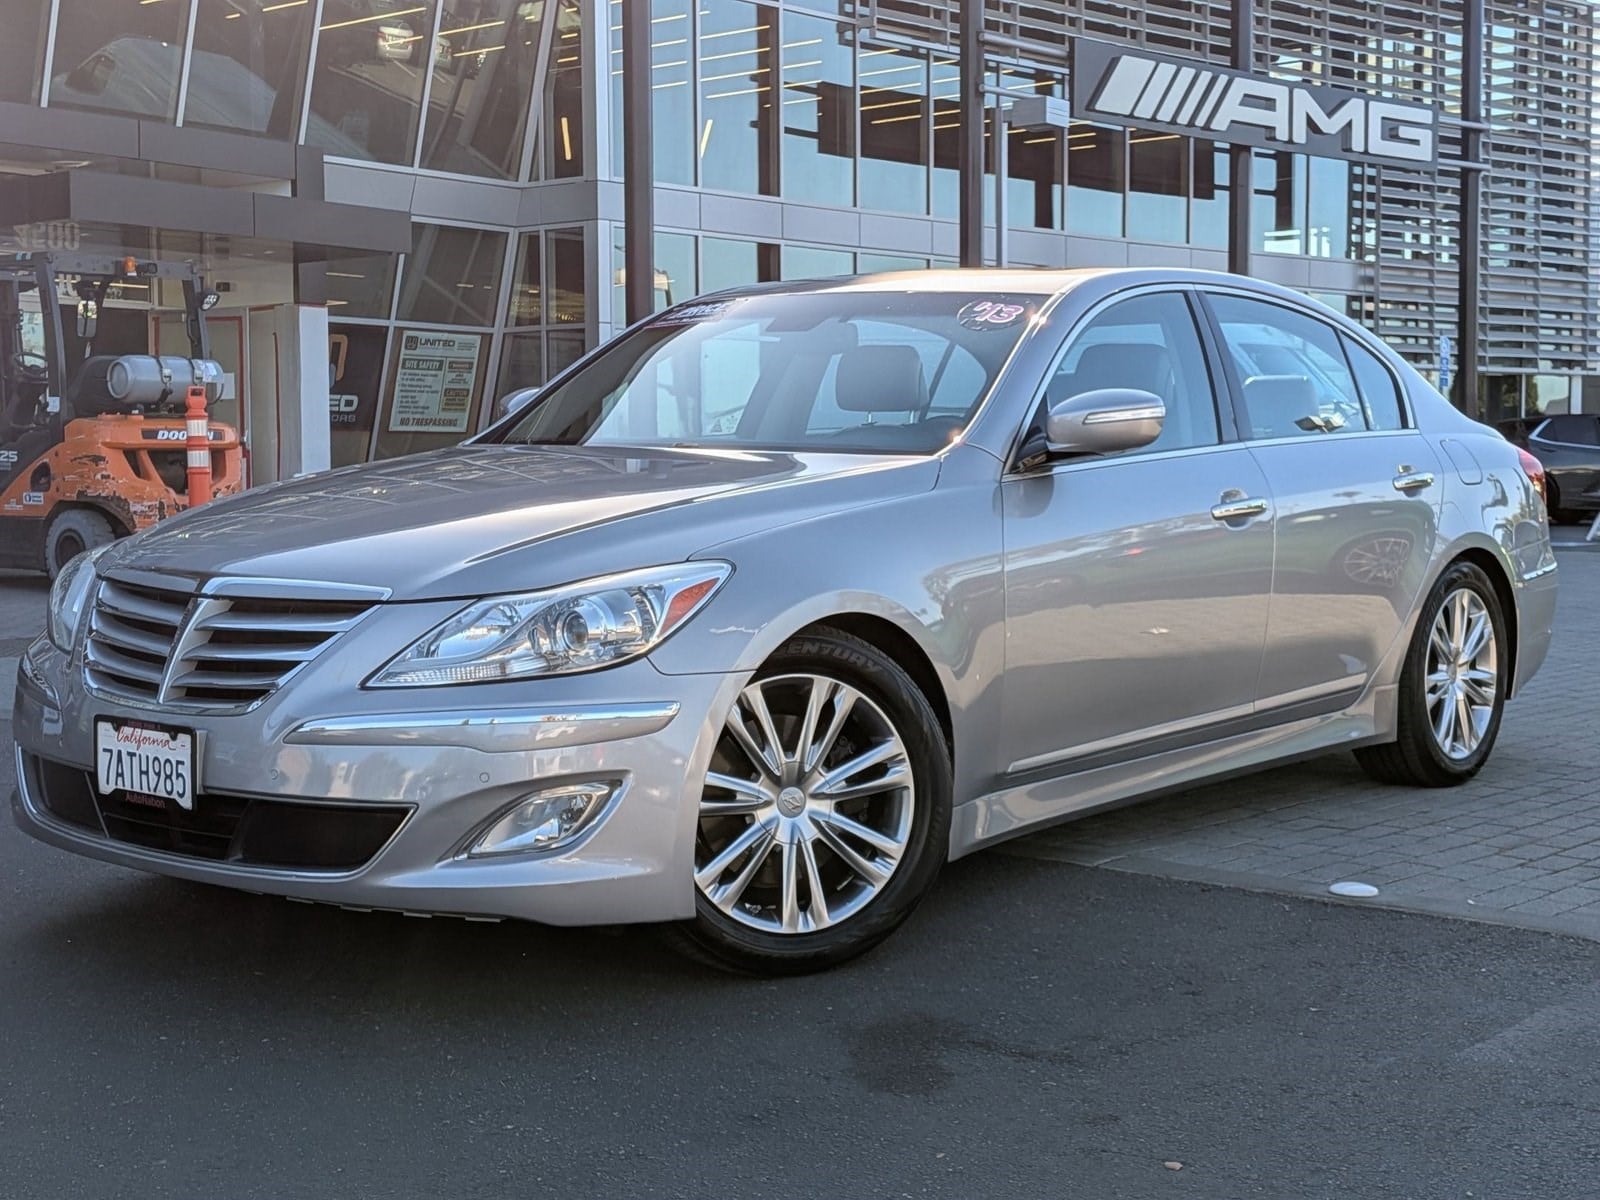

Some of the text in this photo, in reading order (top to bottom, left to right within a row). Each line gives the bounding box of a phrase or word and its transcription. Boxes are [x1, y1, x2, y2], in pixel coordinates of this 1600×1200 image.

[1209, 76, 1434, 162] AMG
[419, 338, 456, 348] UNITED
[400, 417, 410, 426] NO
[116, 726, 176, 751] California
[102, 747, 187, 799] 7ATH985
